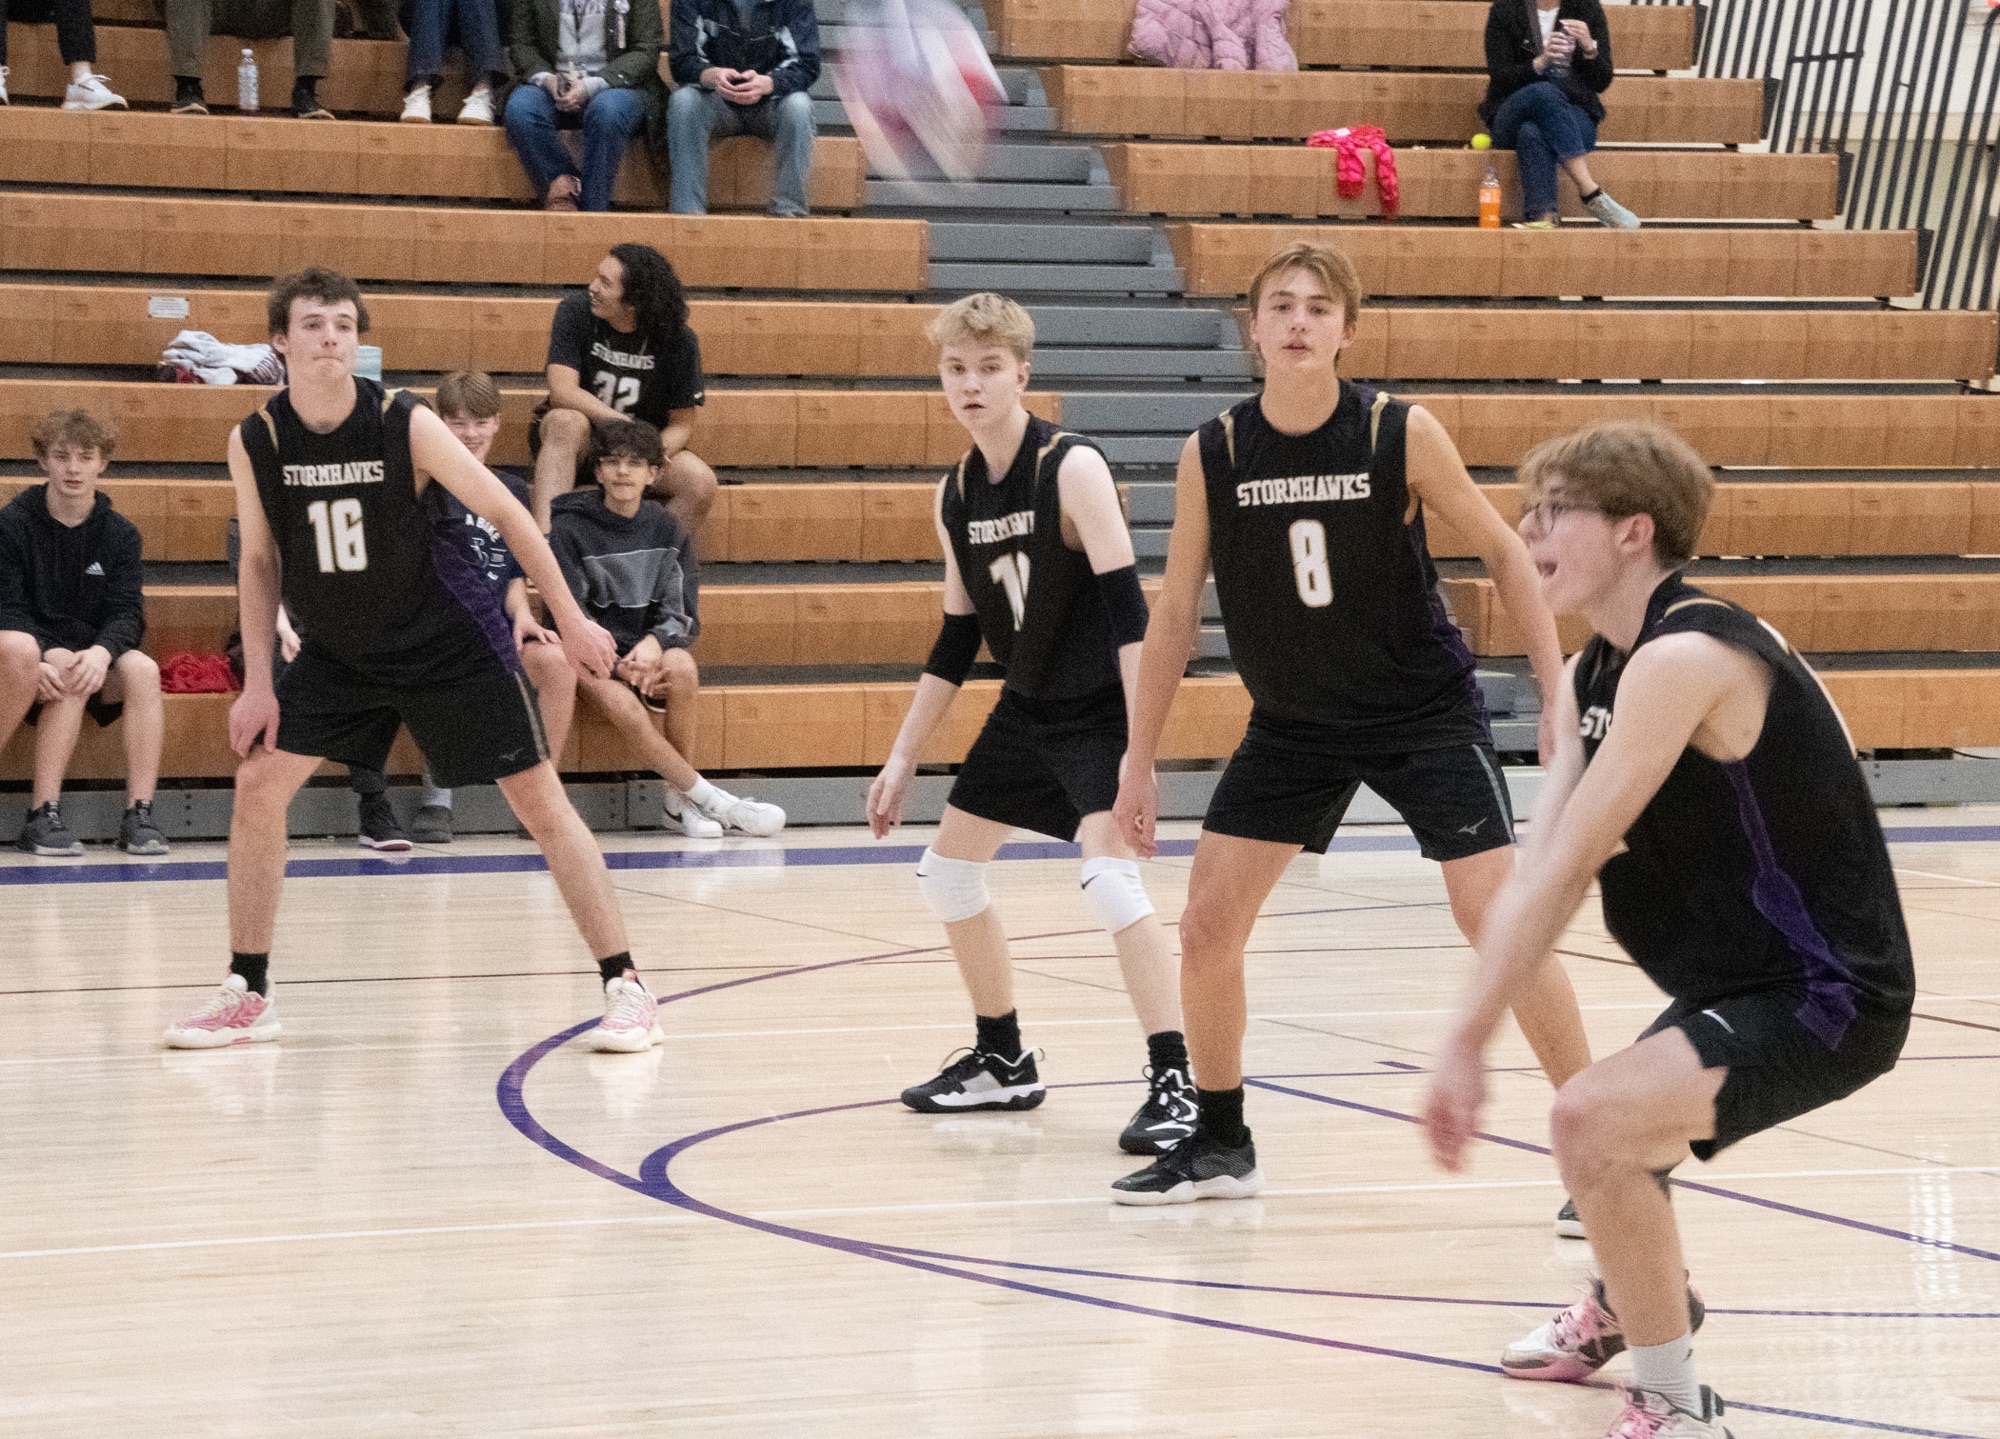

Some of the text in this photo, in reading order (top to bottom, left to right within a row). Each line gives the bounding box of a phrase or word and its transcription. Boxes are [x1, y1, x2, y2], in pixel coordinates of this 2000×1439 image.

[283, 460, 384, 487] STORMHAWKS
[1236, 472, 1371, 507] STORMHAWKS
[307, 498, 368, 573] 16
[1289, 519, 1334, 608] 8
